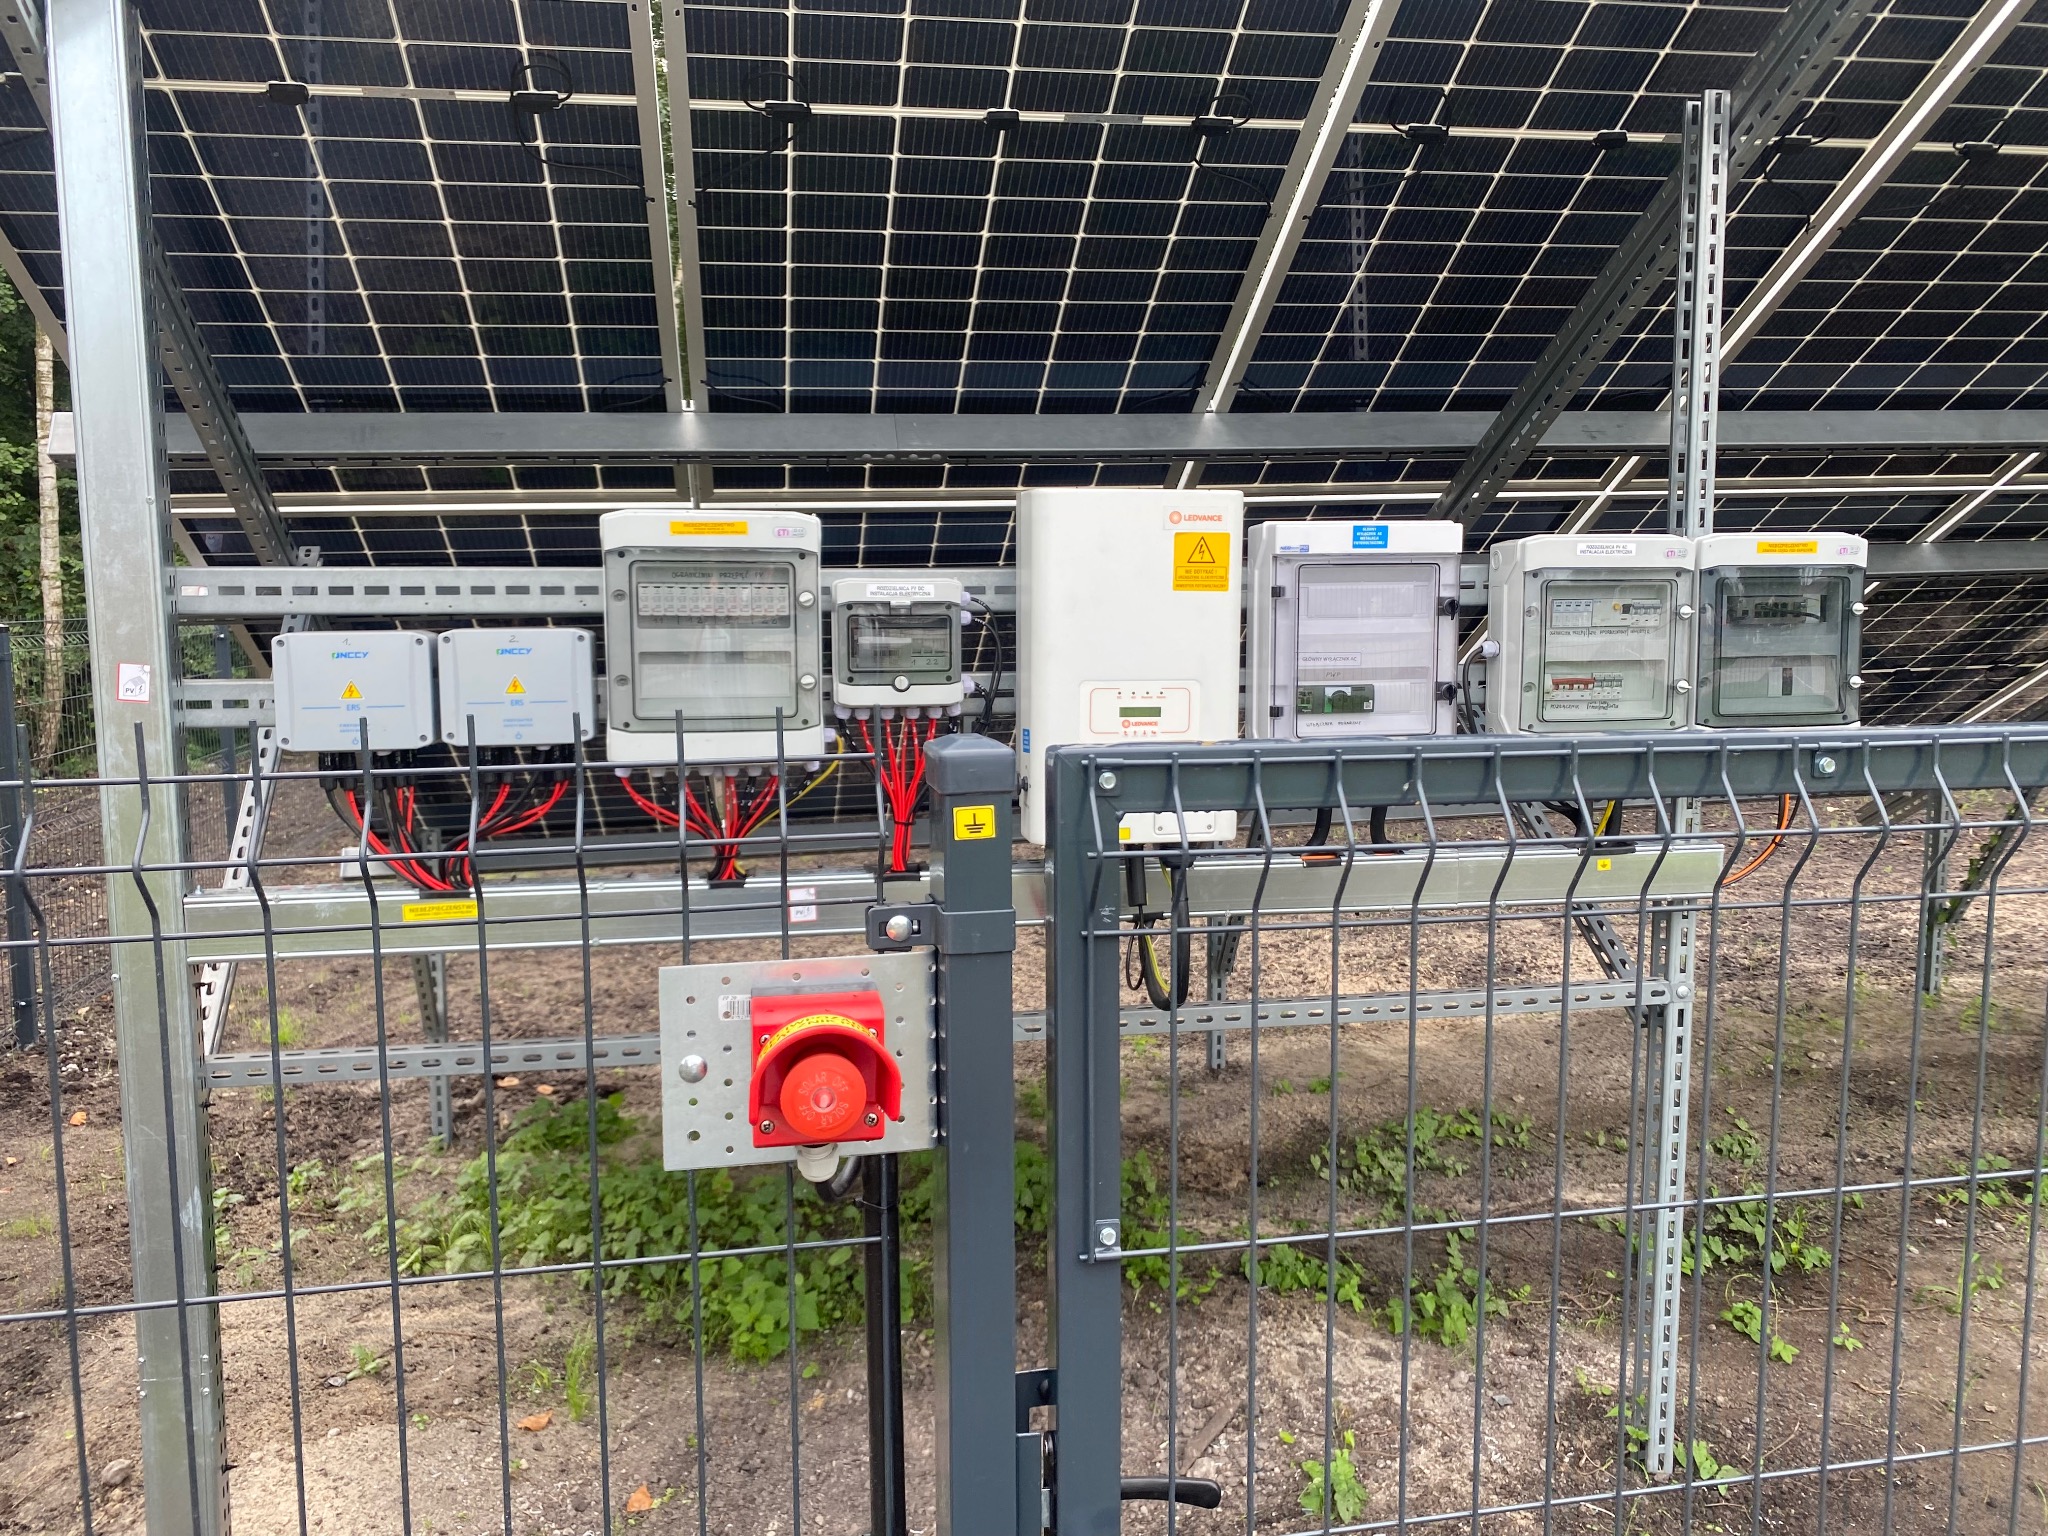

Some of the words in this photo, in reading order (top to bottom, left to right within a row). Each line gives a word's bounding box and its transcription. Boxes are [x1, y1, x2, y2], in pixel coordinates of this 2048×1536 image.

[1183, 514, 1223, 522] LEDVANCE
[777, 528, 790, 537] ETI
[798, 1071, 827, 1096] SOLAR
[831, 1075, 849, 1092] OFF
[798, 1104, 816, 1121] OFF
[821, 1102, 849, 1125] SOLAR
